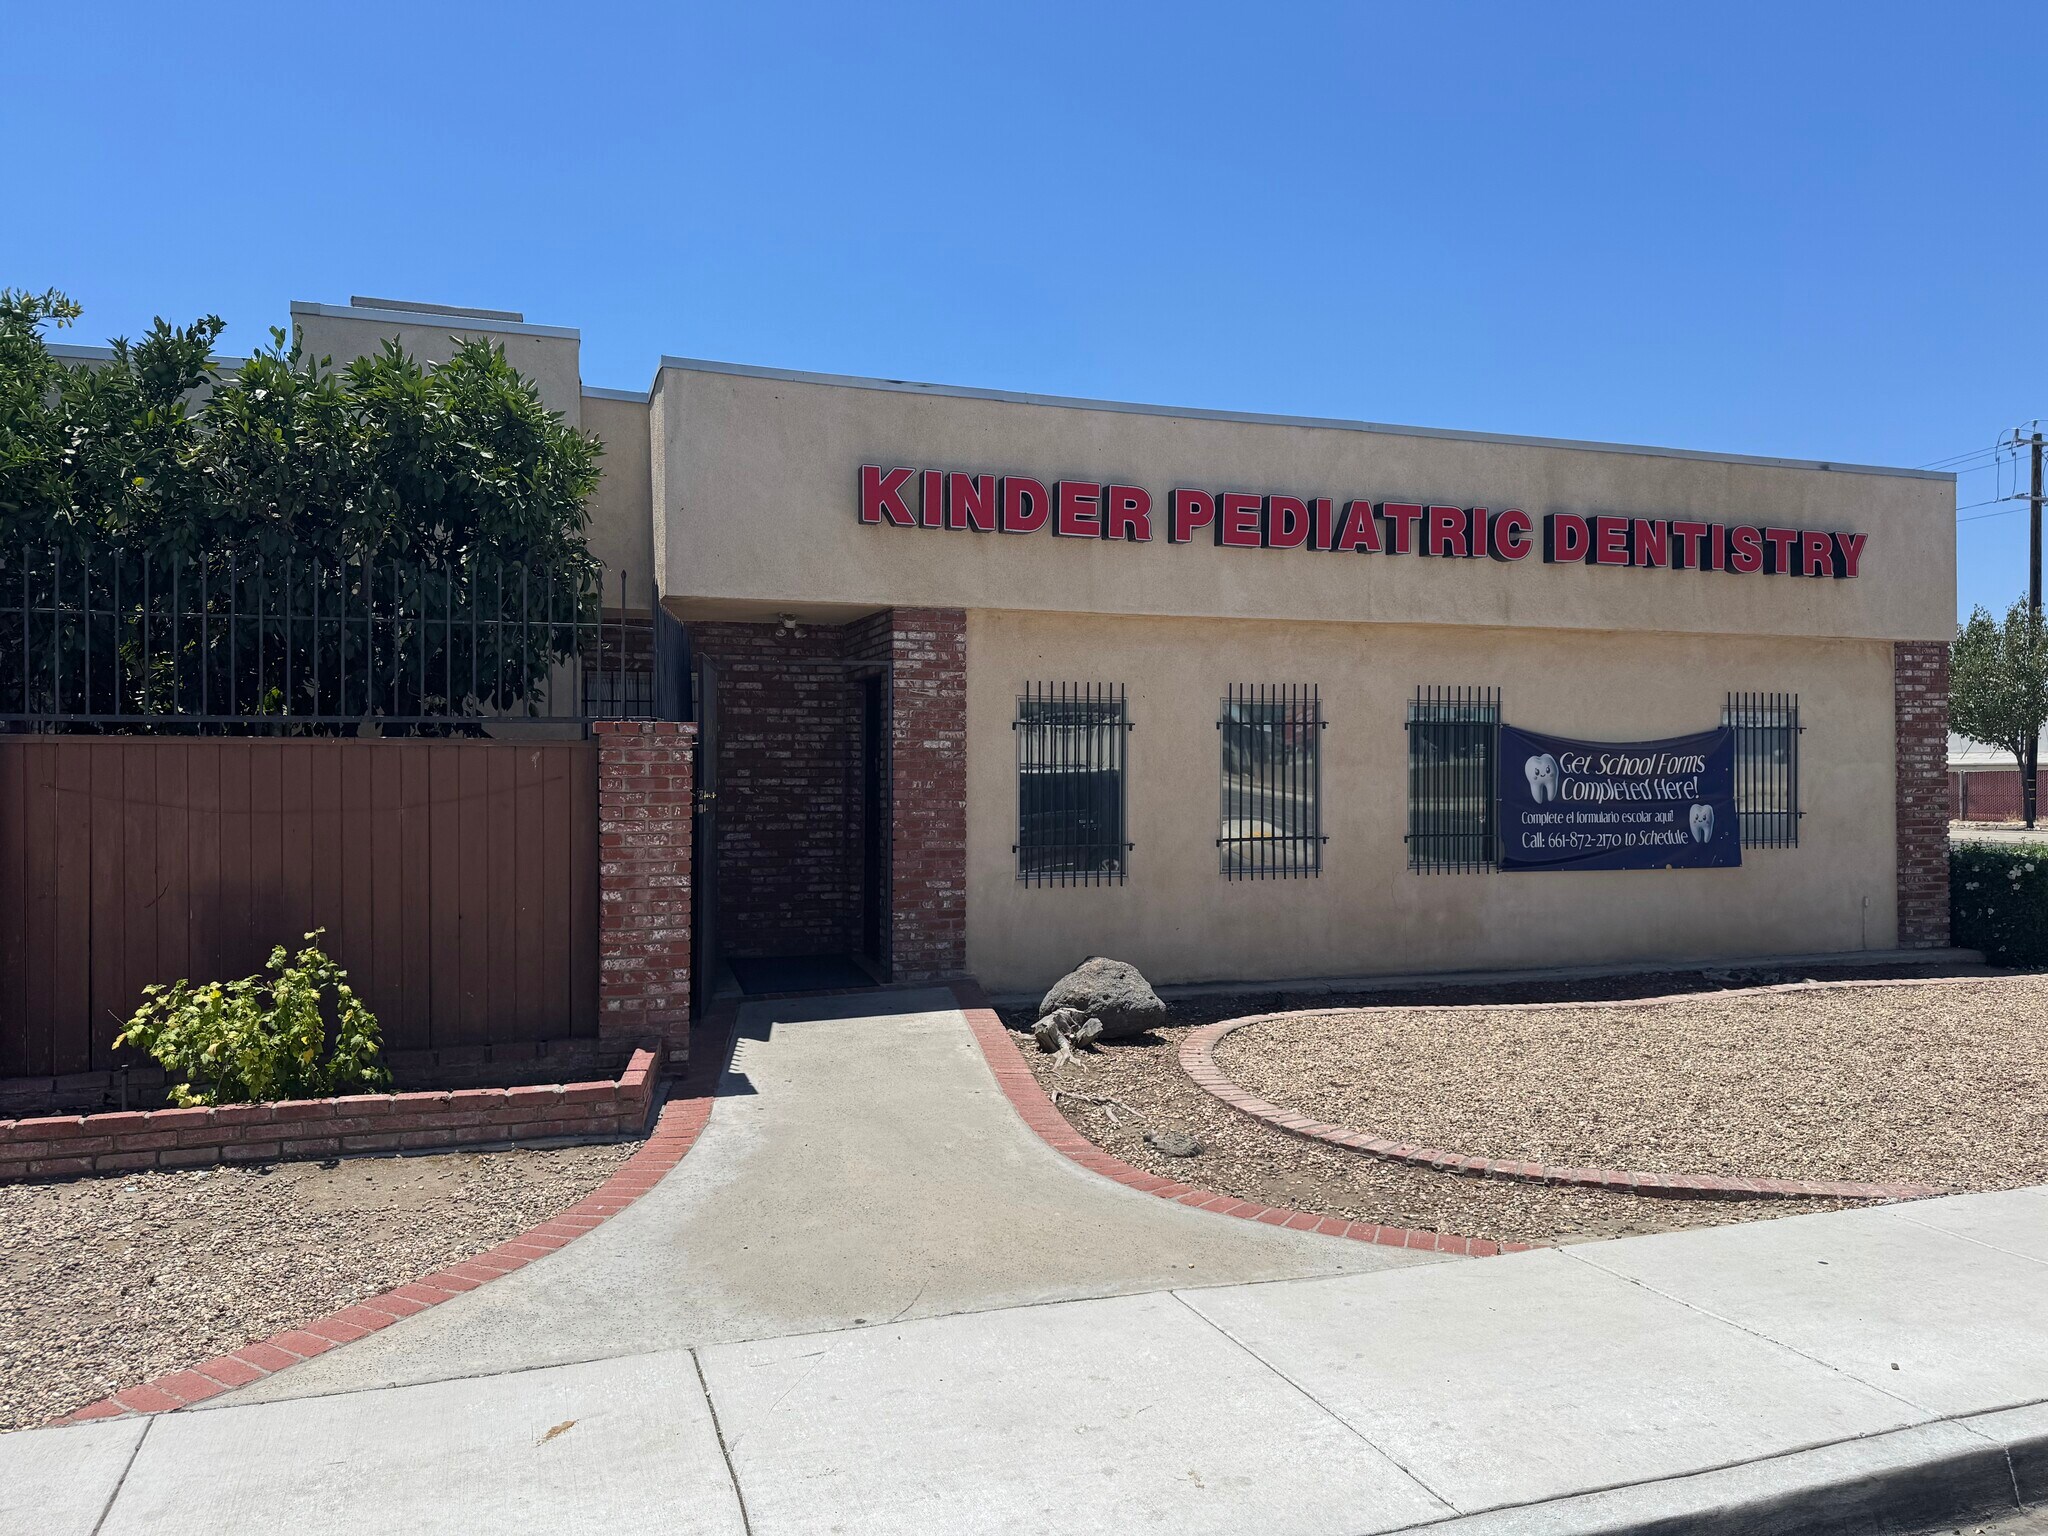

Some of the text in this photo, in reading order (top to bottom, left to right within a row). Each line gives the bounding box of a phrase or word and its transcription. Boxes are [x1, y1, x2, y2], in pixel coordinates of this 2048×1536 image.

[859, 464, 1868, 578] KINDER PEDIATRIC DENTISTRY
[1559, 752, 1706, 776] Get School Forms
[1561, 776, 1700, 804] Completed Here!
[1521, 811, 1564, 826] Complete
[1566, 811, 1574, 824] el
[1576, 810, 1620, 824] formulario
[1621, 810, 1651, 823] escolar
[1521, 829, 1689, 850] Call: 661-872-2170 to Schedule
